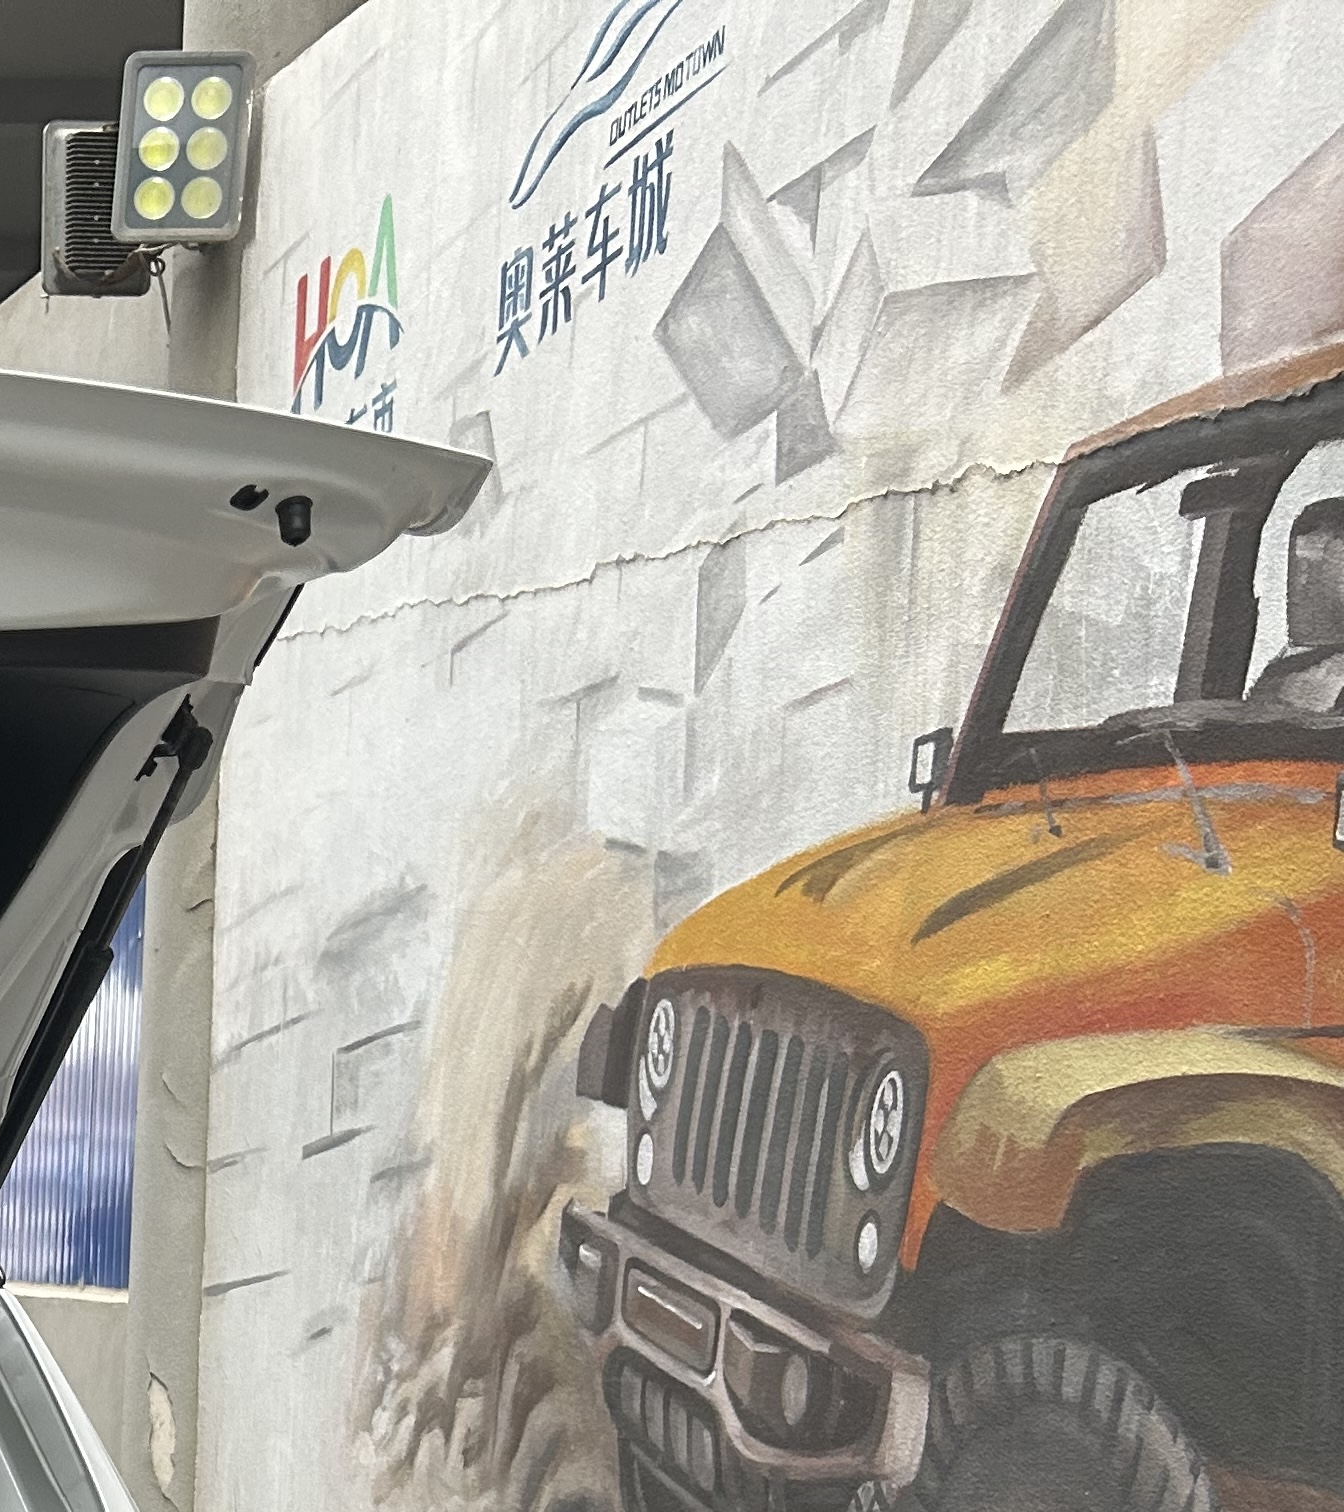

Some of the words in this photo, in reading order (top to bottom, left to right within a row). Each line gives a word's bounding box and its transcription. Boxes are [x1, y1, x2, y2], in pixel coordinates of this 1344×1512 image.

[609, 77, 663, 147] OUTLETS
[493, 128, 674, 377] 奥莱车城
